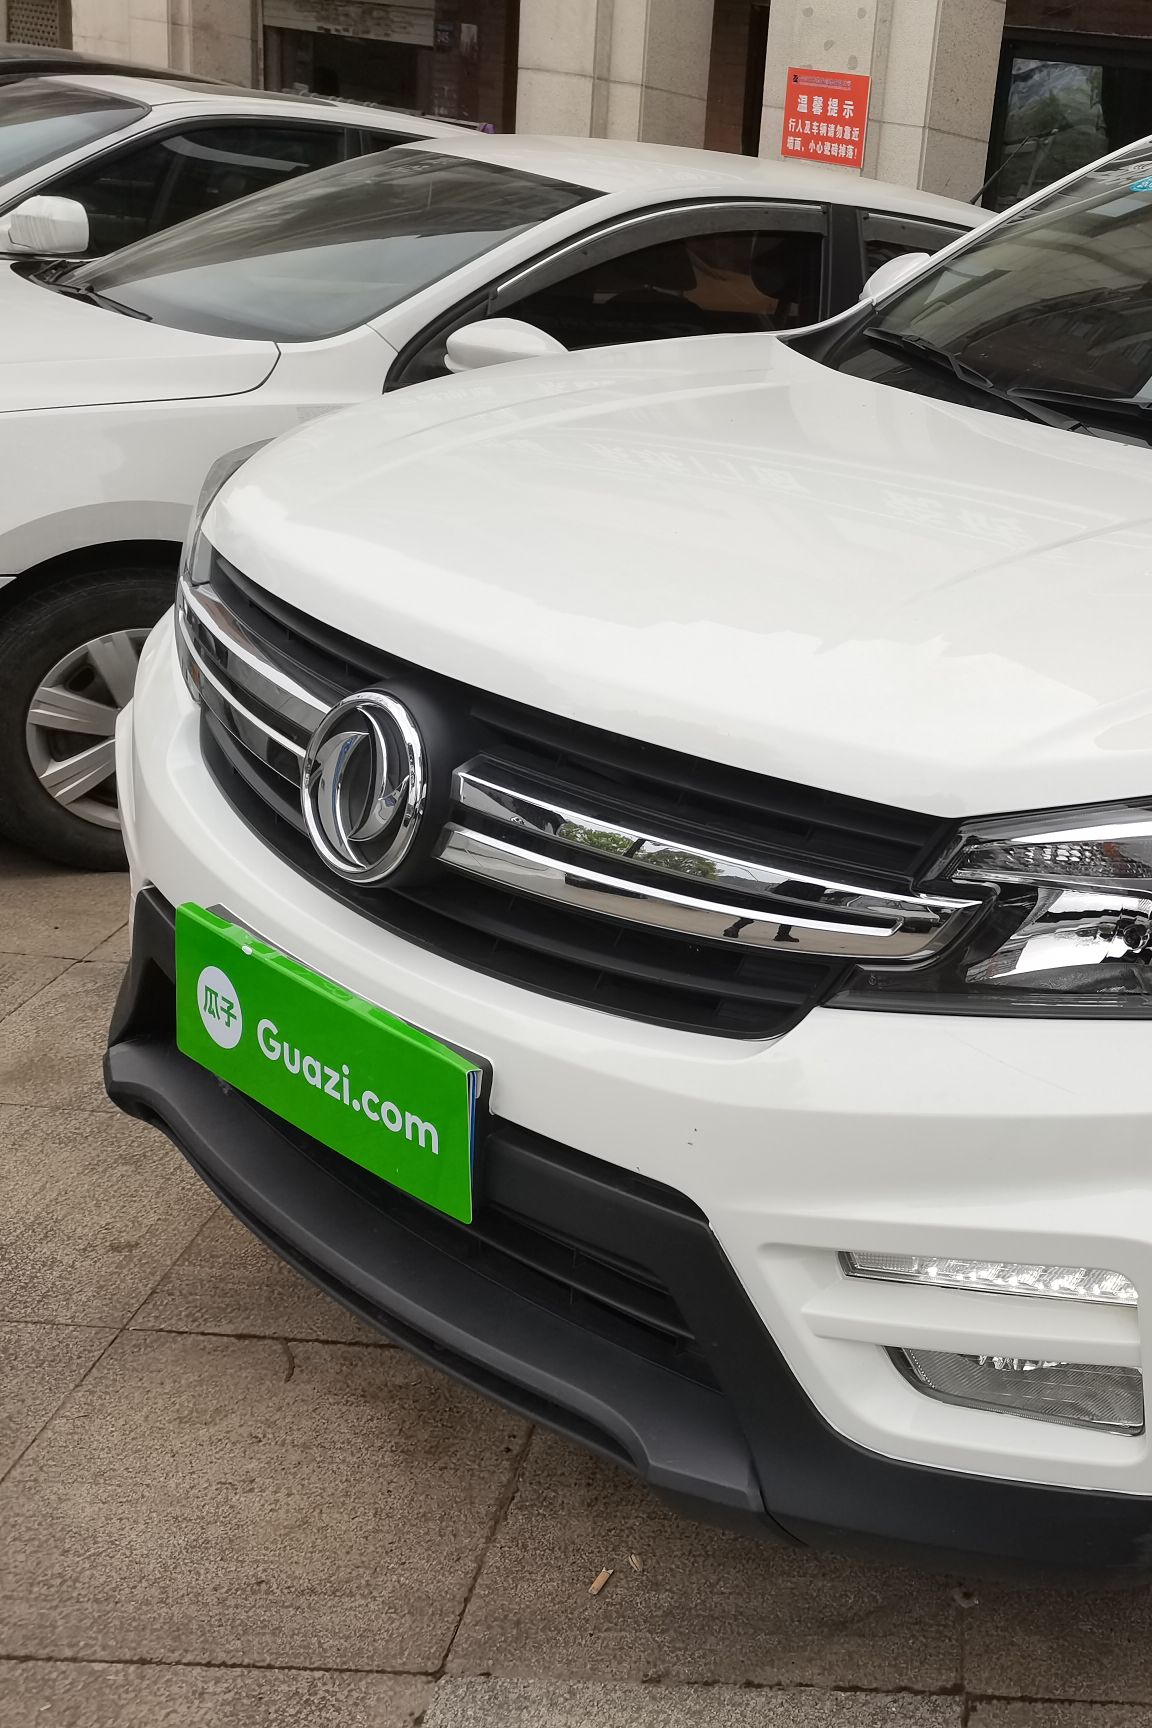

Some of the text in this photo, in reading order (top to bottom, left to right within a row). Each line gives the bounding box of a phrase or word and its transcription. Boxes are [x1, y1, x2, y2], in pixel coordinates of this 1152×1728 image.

[797, 94, 854, 119] 温馨提示
[788, 118, 860, 141] 行人及车辆请勿靠近
[203, 985, 237, 1028] 瓜子
[256, 1018, 439, 1155] Guazi.com
